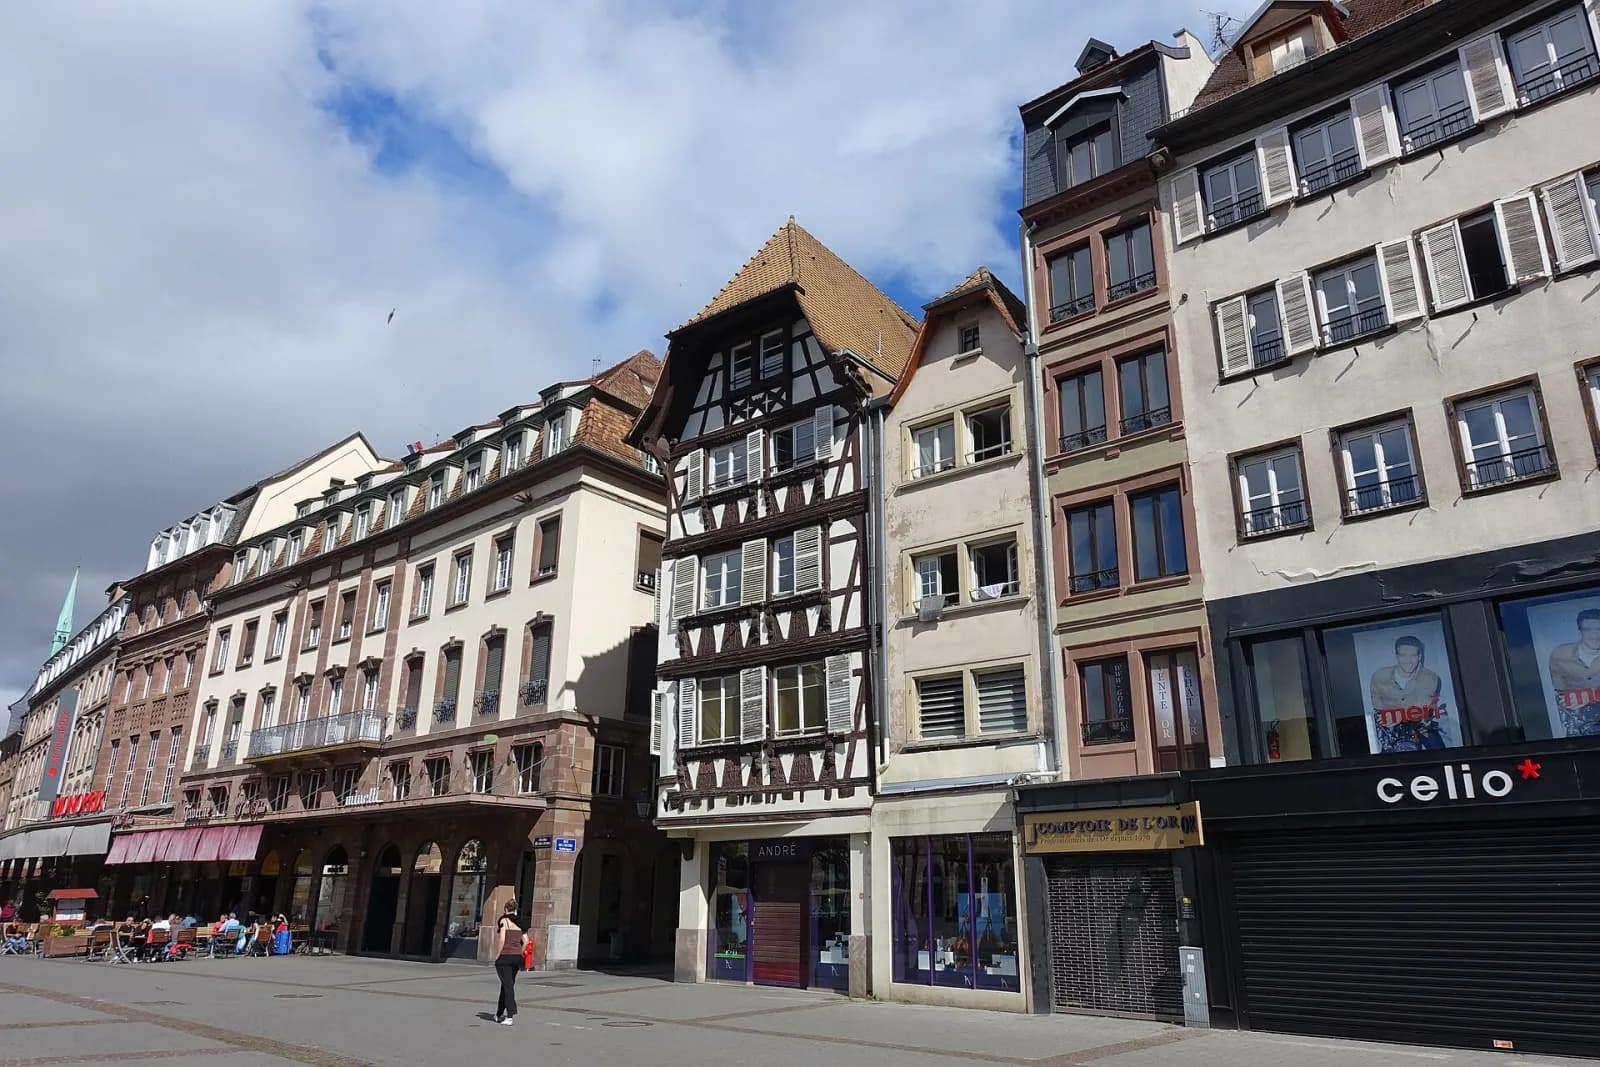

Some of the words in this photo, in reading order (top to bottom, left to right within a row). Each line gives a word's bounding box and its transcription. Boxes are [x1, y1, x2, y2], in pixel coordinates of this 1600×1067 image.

[1380, 703, 1441, 726] men
[1161, 720, 1171, 738] OR
[1037, 819, 1112, 834] COMPTOIR
[1118, 817, 1139, 831] DE
[758, 842, 797, 857] ANDRÉ
